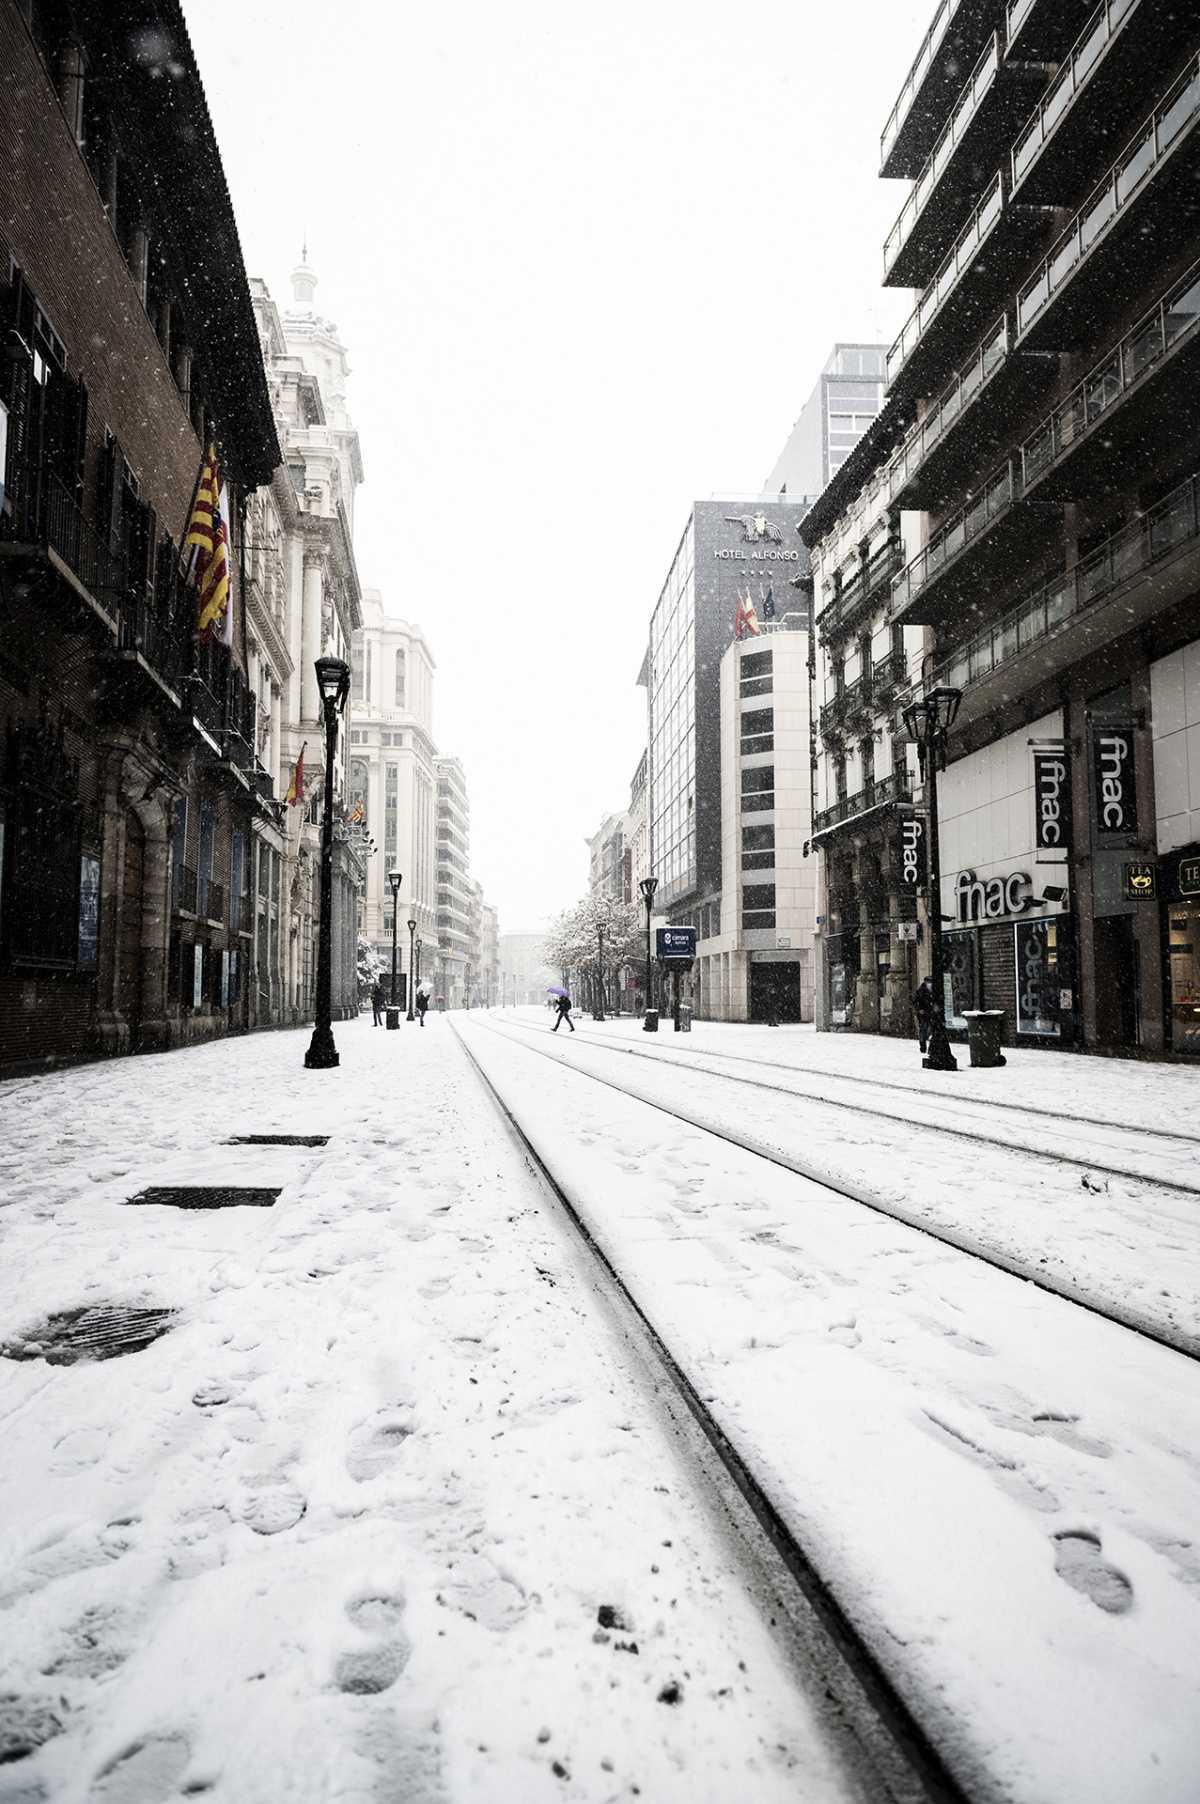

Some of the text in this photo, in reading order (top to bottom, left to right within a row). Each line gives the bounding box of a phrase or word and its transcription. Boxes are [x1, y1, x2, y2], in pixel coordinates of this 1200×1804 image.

[714, 549, 799, 560] HOTEL ALFONSO
[1040, 760, 1066, 843] fnac
[1100, 736, 1128, 827] fnac
[903, 820, 922, 882] fnac
[1129, 866, 1151, 875] TEA
[954, 869, 1030, 922] fnac
